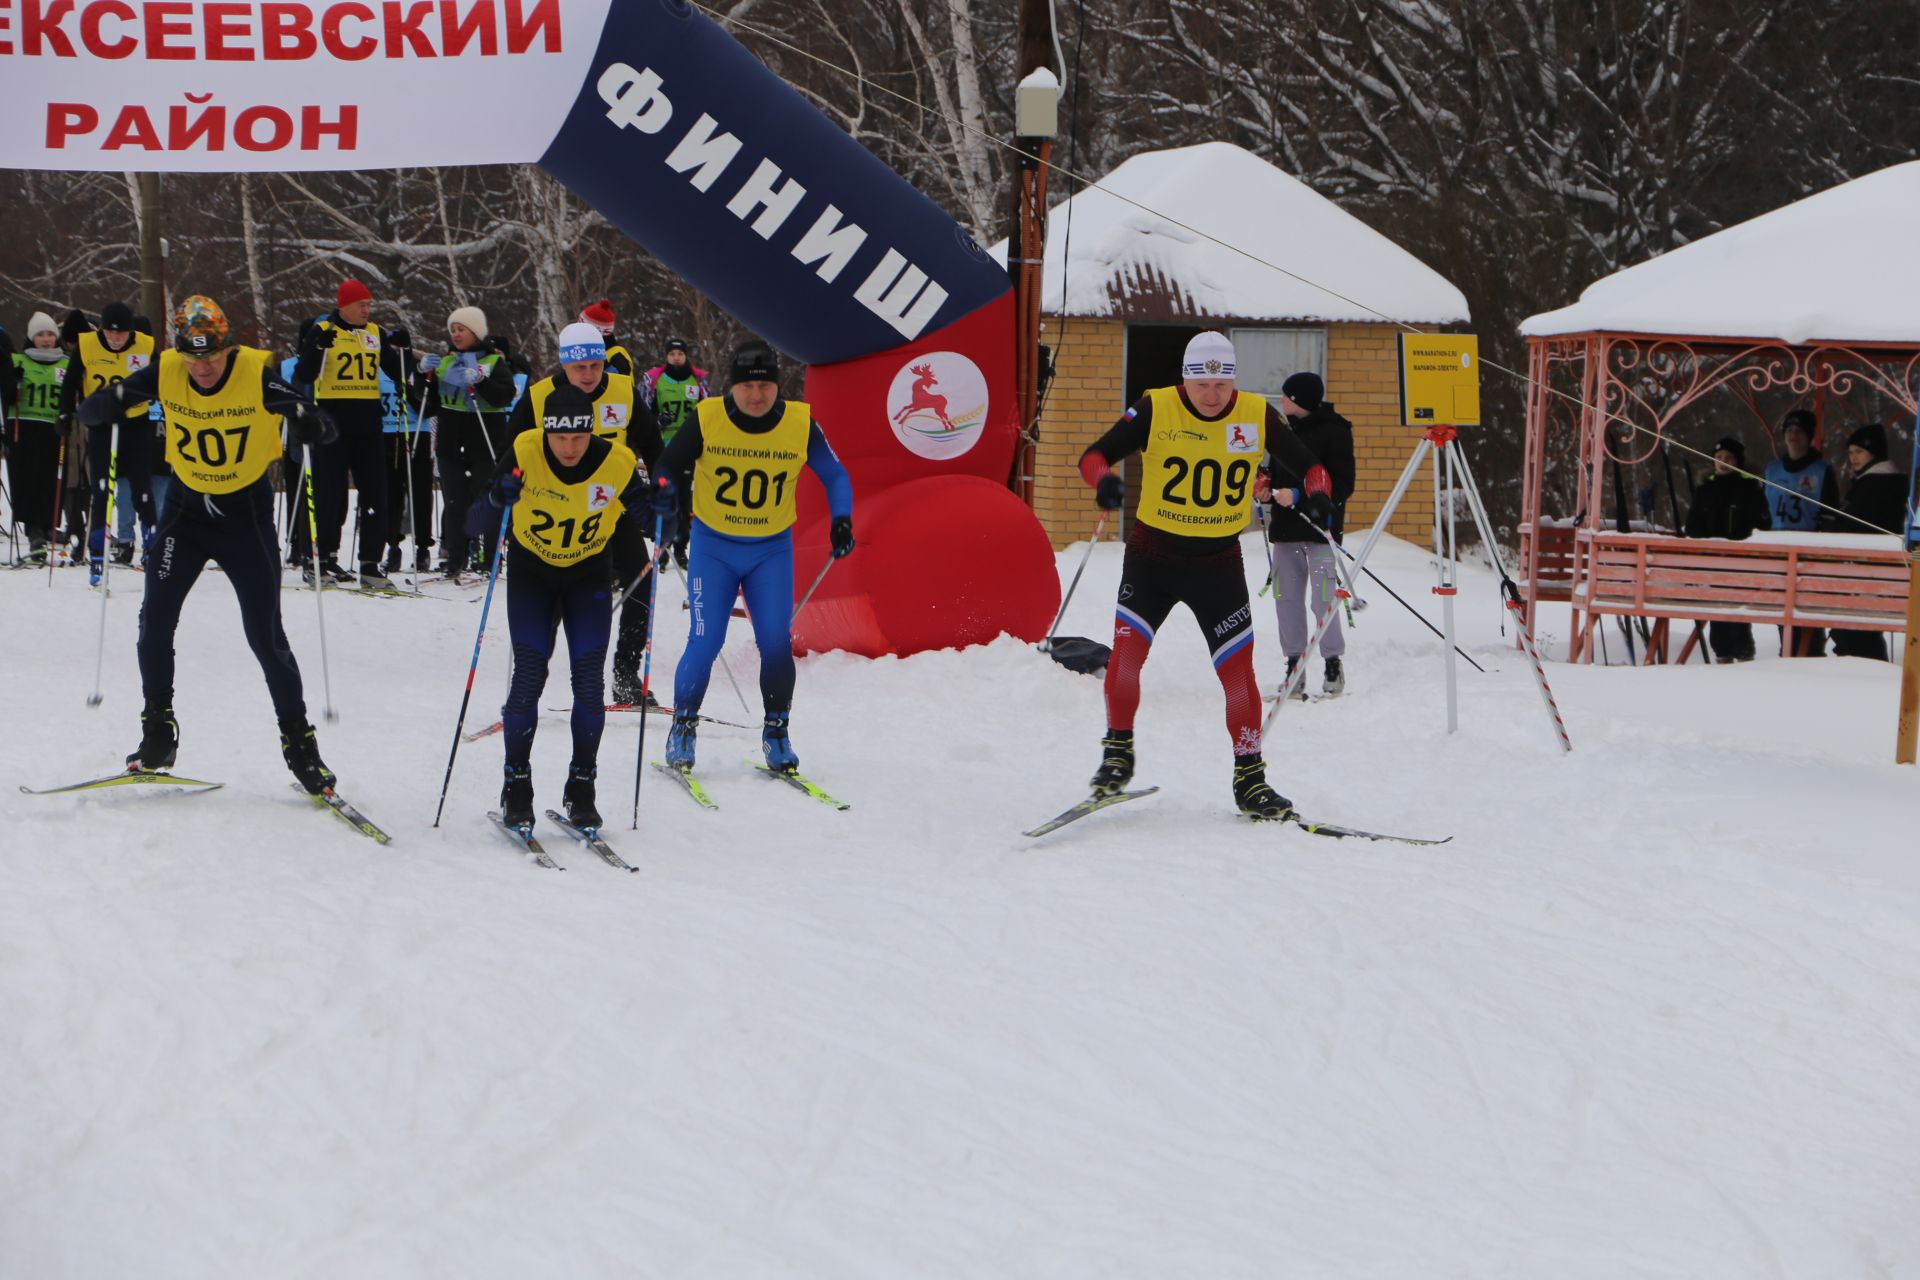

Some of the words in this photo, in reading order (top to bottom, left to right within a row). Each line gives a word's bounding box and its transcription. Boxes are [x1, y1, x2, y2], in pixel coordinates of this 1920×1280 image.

[45, 92, 359, 152] РАЙОН
[596, 62, 950, 341] ФИНИШ
[336, 352, 378, 380] 213
[27, 383, 61, 409] 115
[226, 405, 256, 417] РАЙОН
[543, 415, 592, 429] CRAFT
[173, 421, 251, 467] 207
[706, 445, 771, 459] АЛЕКСЕЕВСКИЙ
[772, 450, 799, 461] РАЙОН
[714, 466, 788, 509] 201
[1162, 456, 1251, 508] 209
[724, 513, 769, 525] МОСТОВИК
[1157, 508, 1223, 525] АЛЕКСЕЕВСКИЙ
[1224, 512, 1243, 524] РАЙОН
[1776, 495, 1802, 524] 43
[530, 509, 603, 548] 218
[160, 536, 175, 571] CRAFT
[523, 530, 581, 559] АЛЕКСЕЕВСКИЙ
[582, 535, 607, 554] РАЙОН
[693, 577, 704, 636] SPINE
